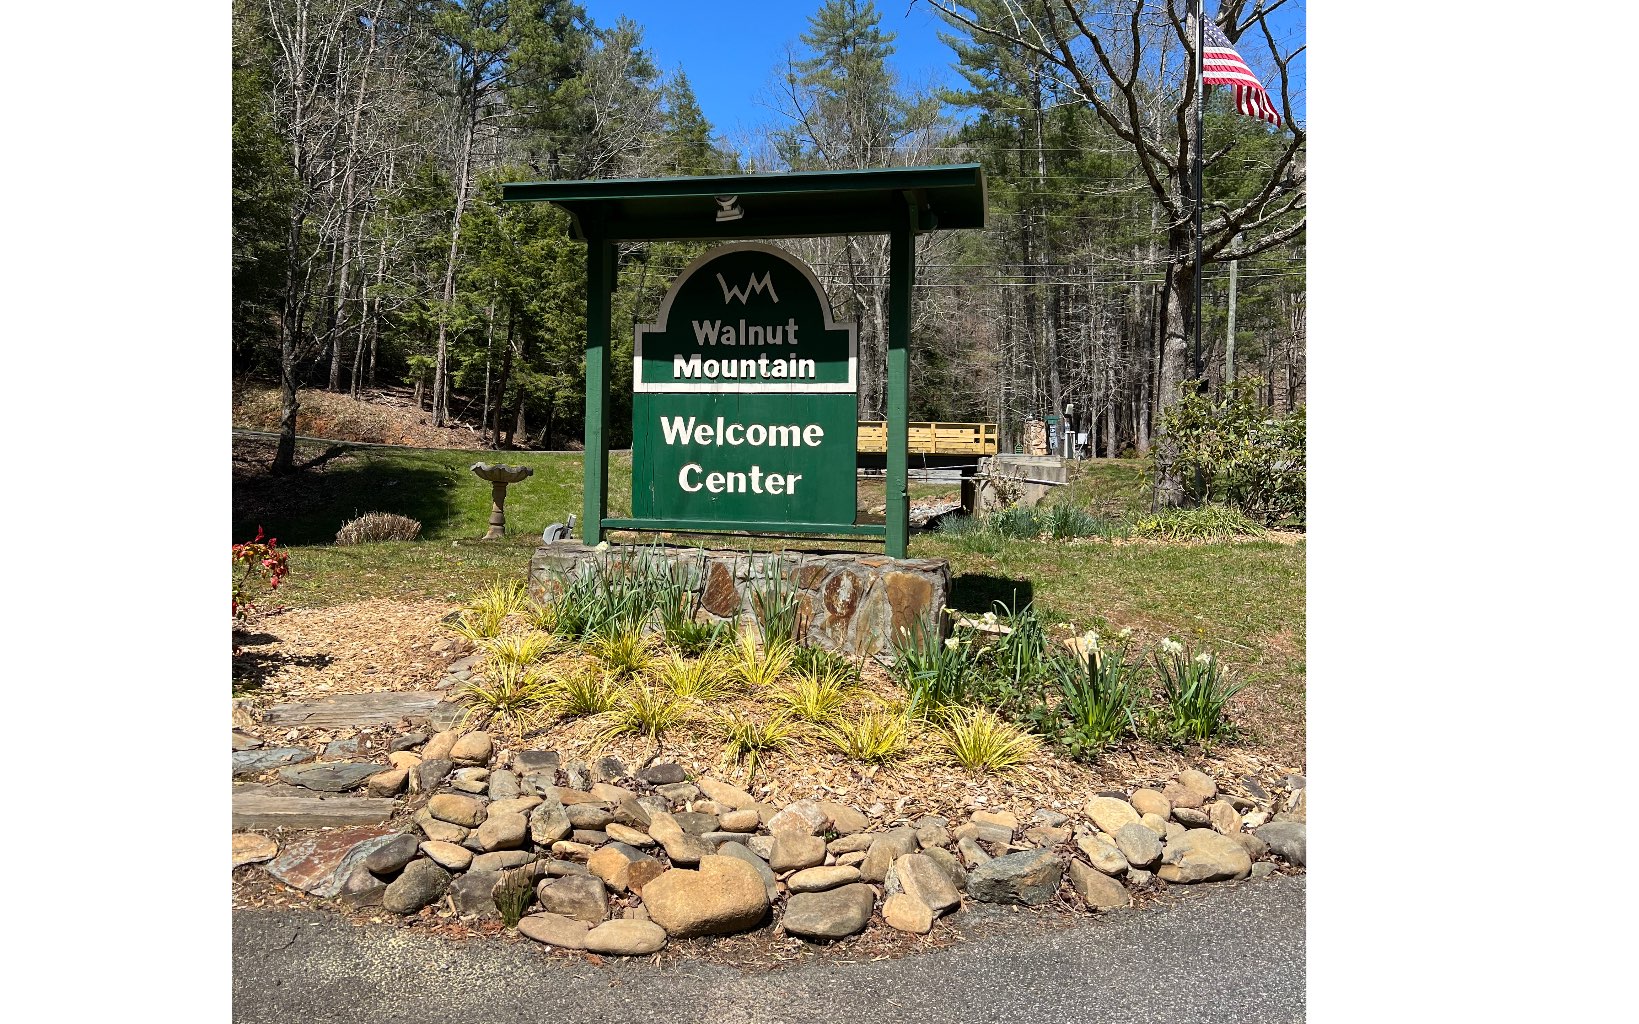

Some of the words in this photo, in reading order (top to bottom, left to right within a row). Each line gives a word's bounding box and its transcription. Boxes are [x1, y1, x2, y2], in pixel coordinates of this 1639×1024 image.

[691, 318, 798, 346] Walnut
[673, 353, 815, 378] Mountain
[660, 416, 824, 447] Welcome
[678, 463, 802, 495] Center
